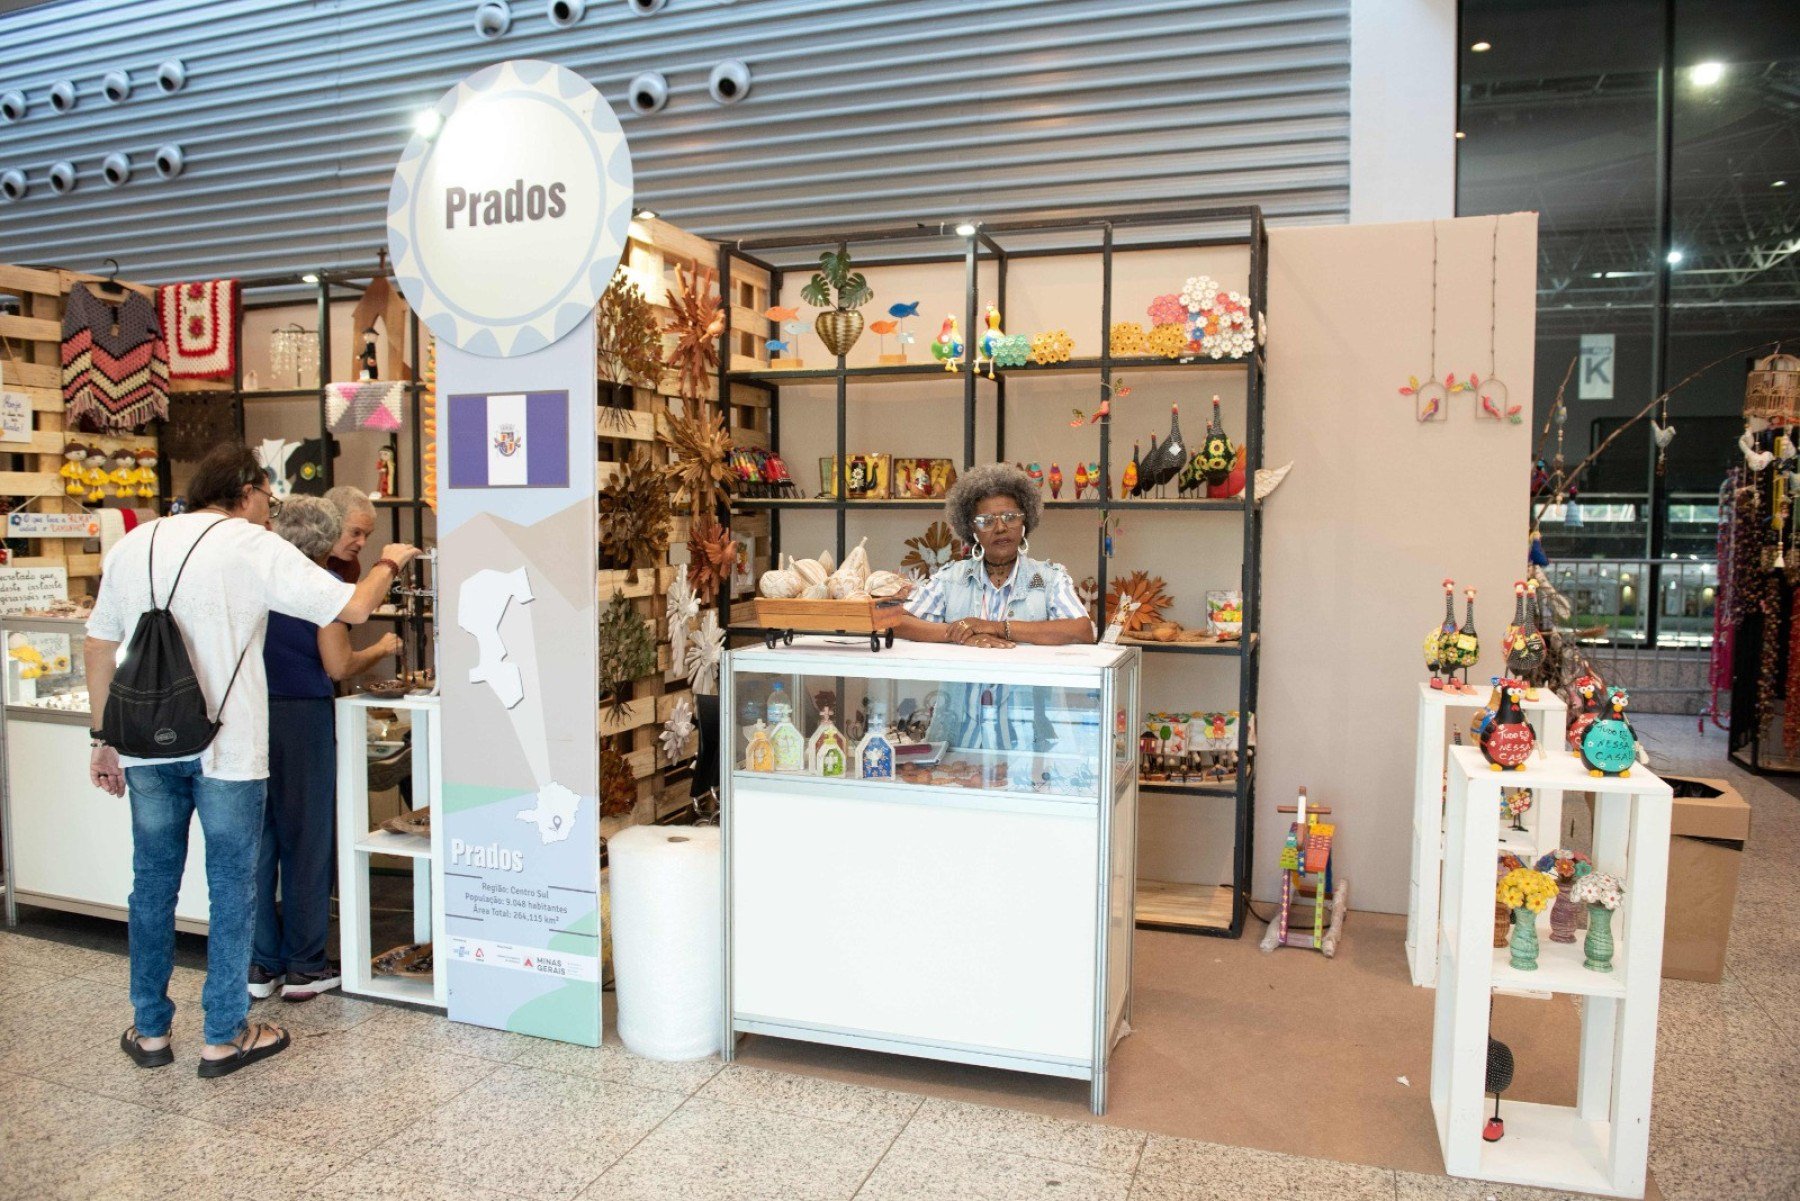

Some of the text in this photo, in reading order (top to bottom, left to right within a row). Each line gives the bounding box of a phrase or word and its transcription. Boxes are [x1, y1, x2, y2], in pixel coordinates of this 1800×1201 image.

[446, 178, 566, 229] Prados
[1585, 357, 1610, 384] K
[451, 838, 523, 873] Prados
[482, 882, 549, 899] Região: Centro Sul
[465, 892, 568, 914] População: 9.048 habitantes
[473, 903, 490, 915] Área
[492, 908, 511, 918] Total:
[544, 916, 559, 924] km²
[536, 957, 562, 967] MINAS
[536, 964, 566, 975] GERAIS
